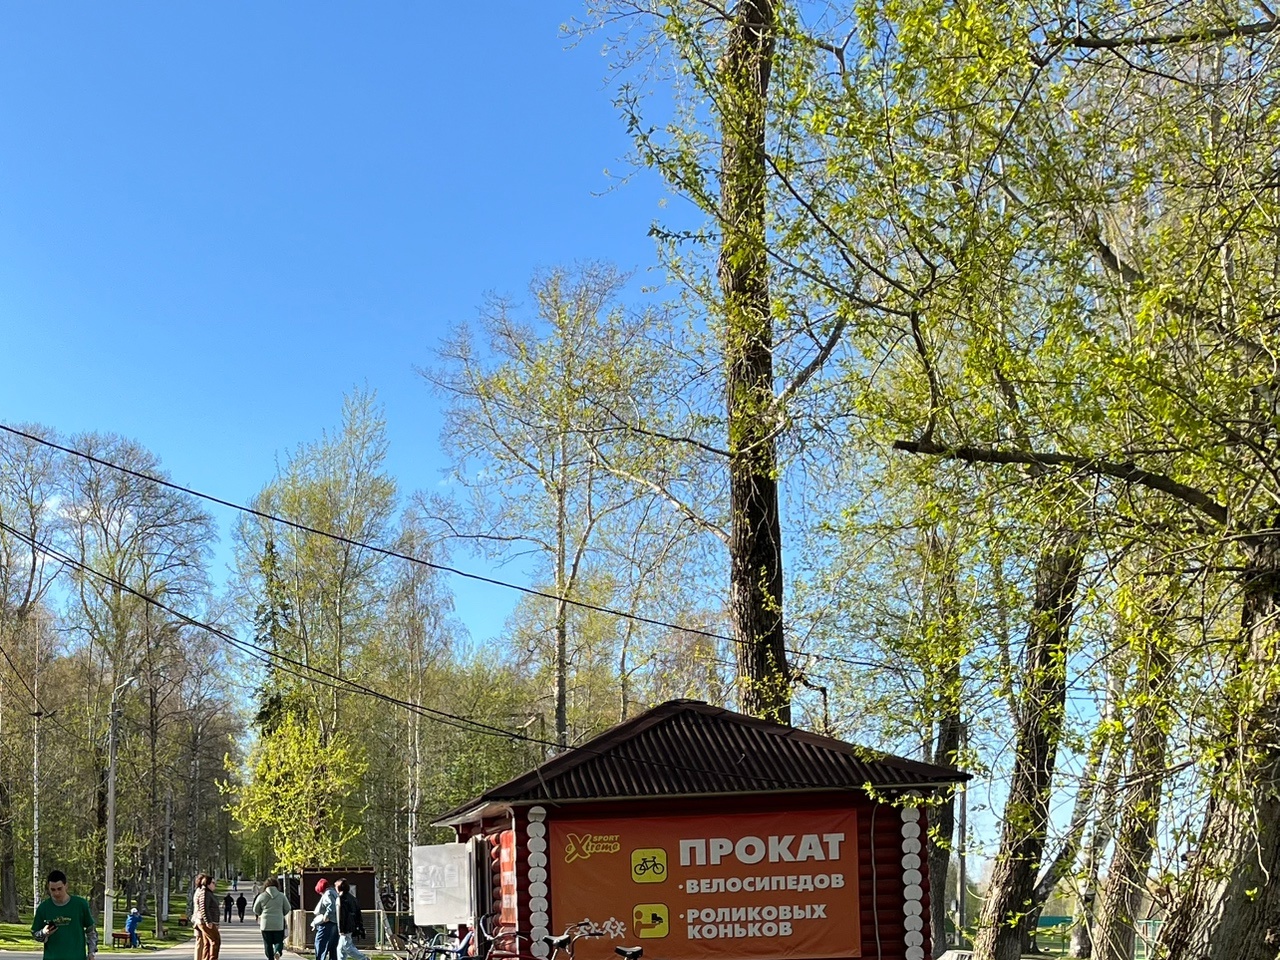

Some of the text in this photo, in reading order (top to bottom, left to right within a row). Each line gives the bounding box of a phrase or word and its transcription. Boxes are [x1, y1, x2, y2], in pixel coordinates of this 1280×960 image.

[592, 834, 620, 842] SPORT
[565, 833, 621, 864] eXtreme
[679, 833, 845, 866] ПРОКАТ
[686, 873, 845, 894] ВЕЛОСИПЕДОВ
[687, 904, 827, 923] РОЛИКОВЫХ
[688, 921, 793, 939] КОНЬКОВ
